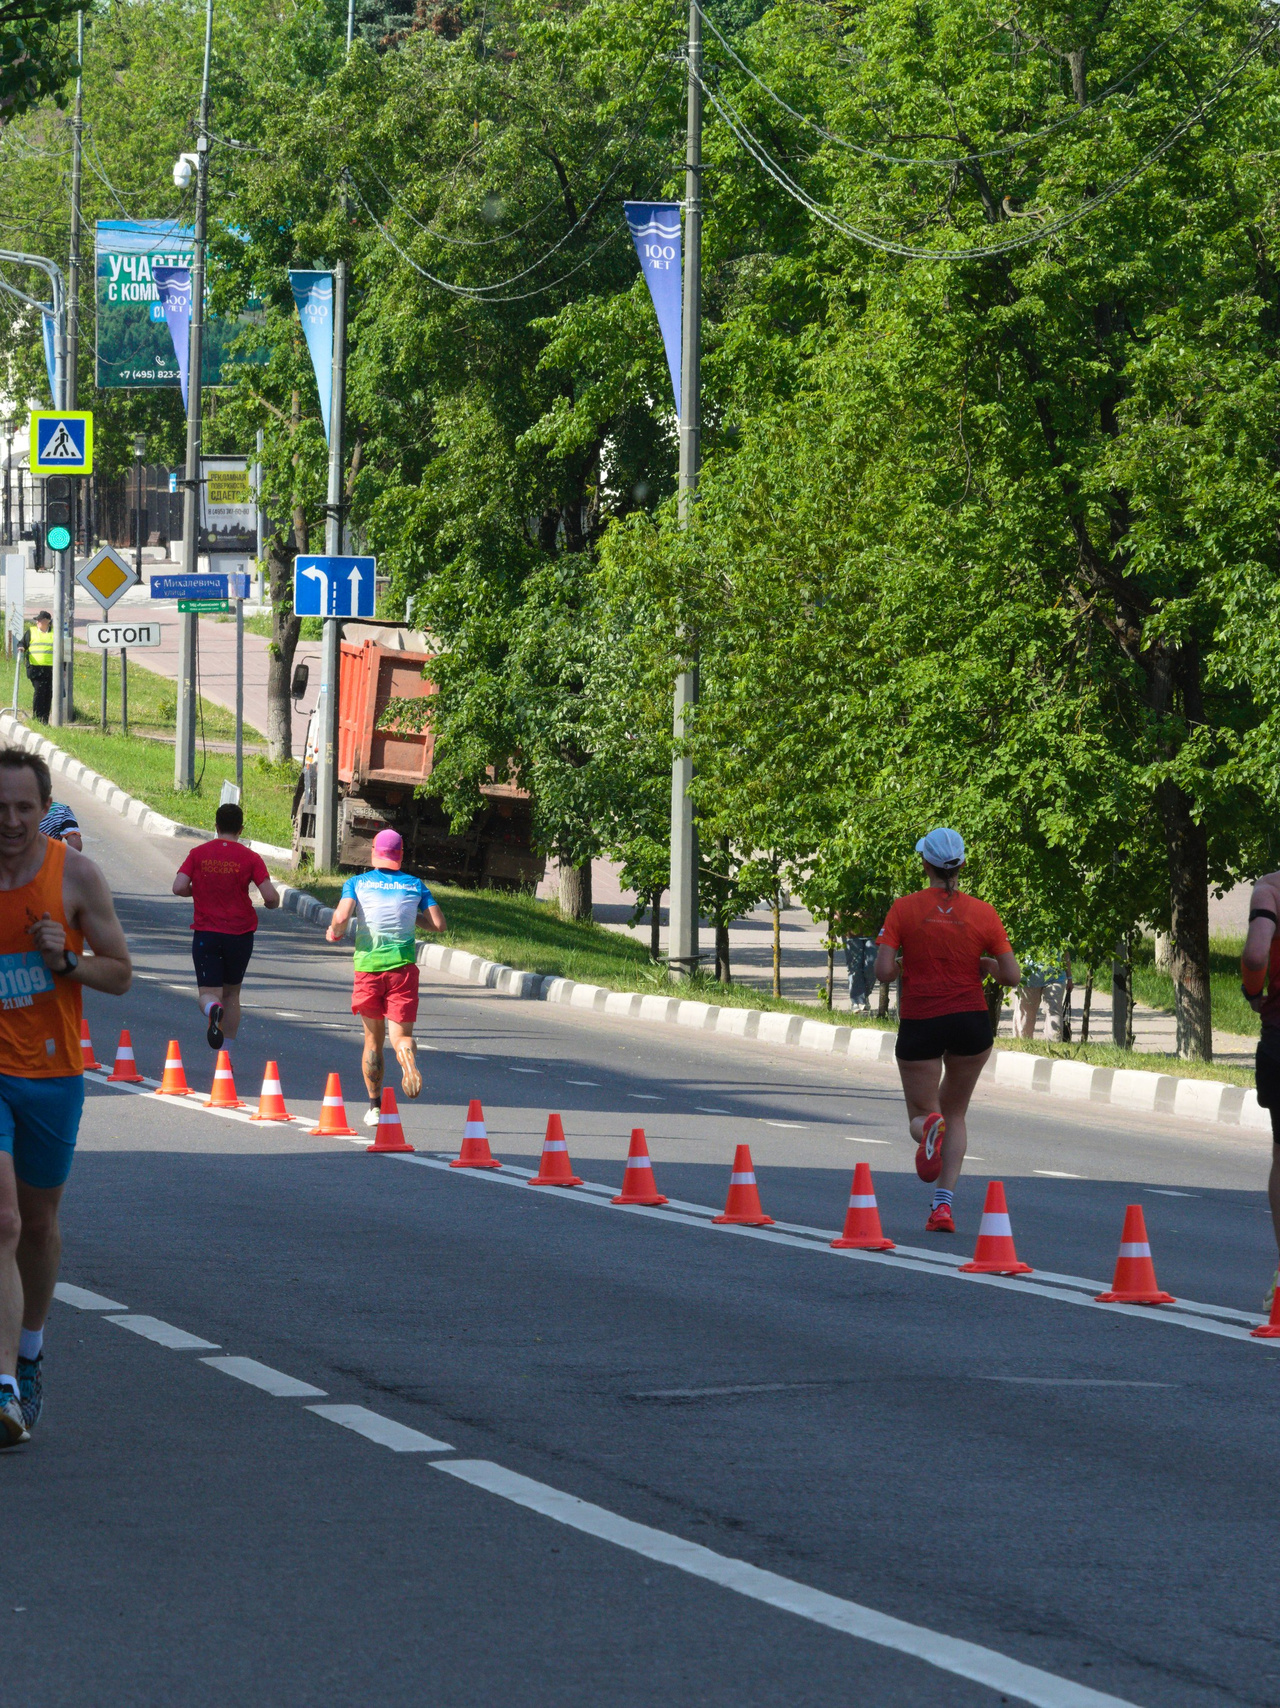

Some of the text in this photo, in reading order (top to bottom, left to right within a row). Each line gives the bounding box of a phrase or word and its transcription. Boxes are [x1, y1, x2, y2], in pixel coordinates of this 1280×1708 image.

[644, 244, 676, 260] 100
[108, 254, 196, 282] УЧАСТК
[648, 259, 671, 270] ЛЕТ
[166, 295, 187, 306] 100
[305, 304, 329, 318] 100
[119, 370, 182, 380] +7 (495) 823-2
[210, 473, 247, 482] РЕКЛАМНАЯ
[210, 482, 247, 490] ПОВЕРХНОСТЬ
[210, 490, 243, 502] СДАЕТС
[163, 579, 221, 588] Михалевича
[163, 589, 186, 597] улица
[97, 626, 151, 644] СТОП
[201, 859, 240, 868] МАРАФОН
[201, 866, 234, 874] МОСКВА
